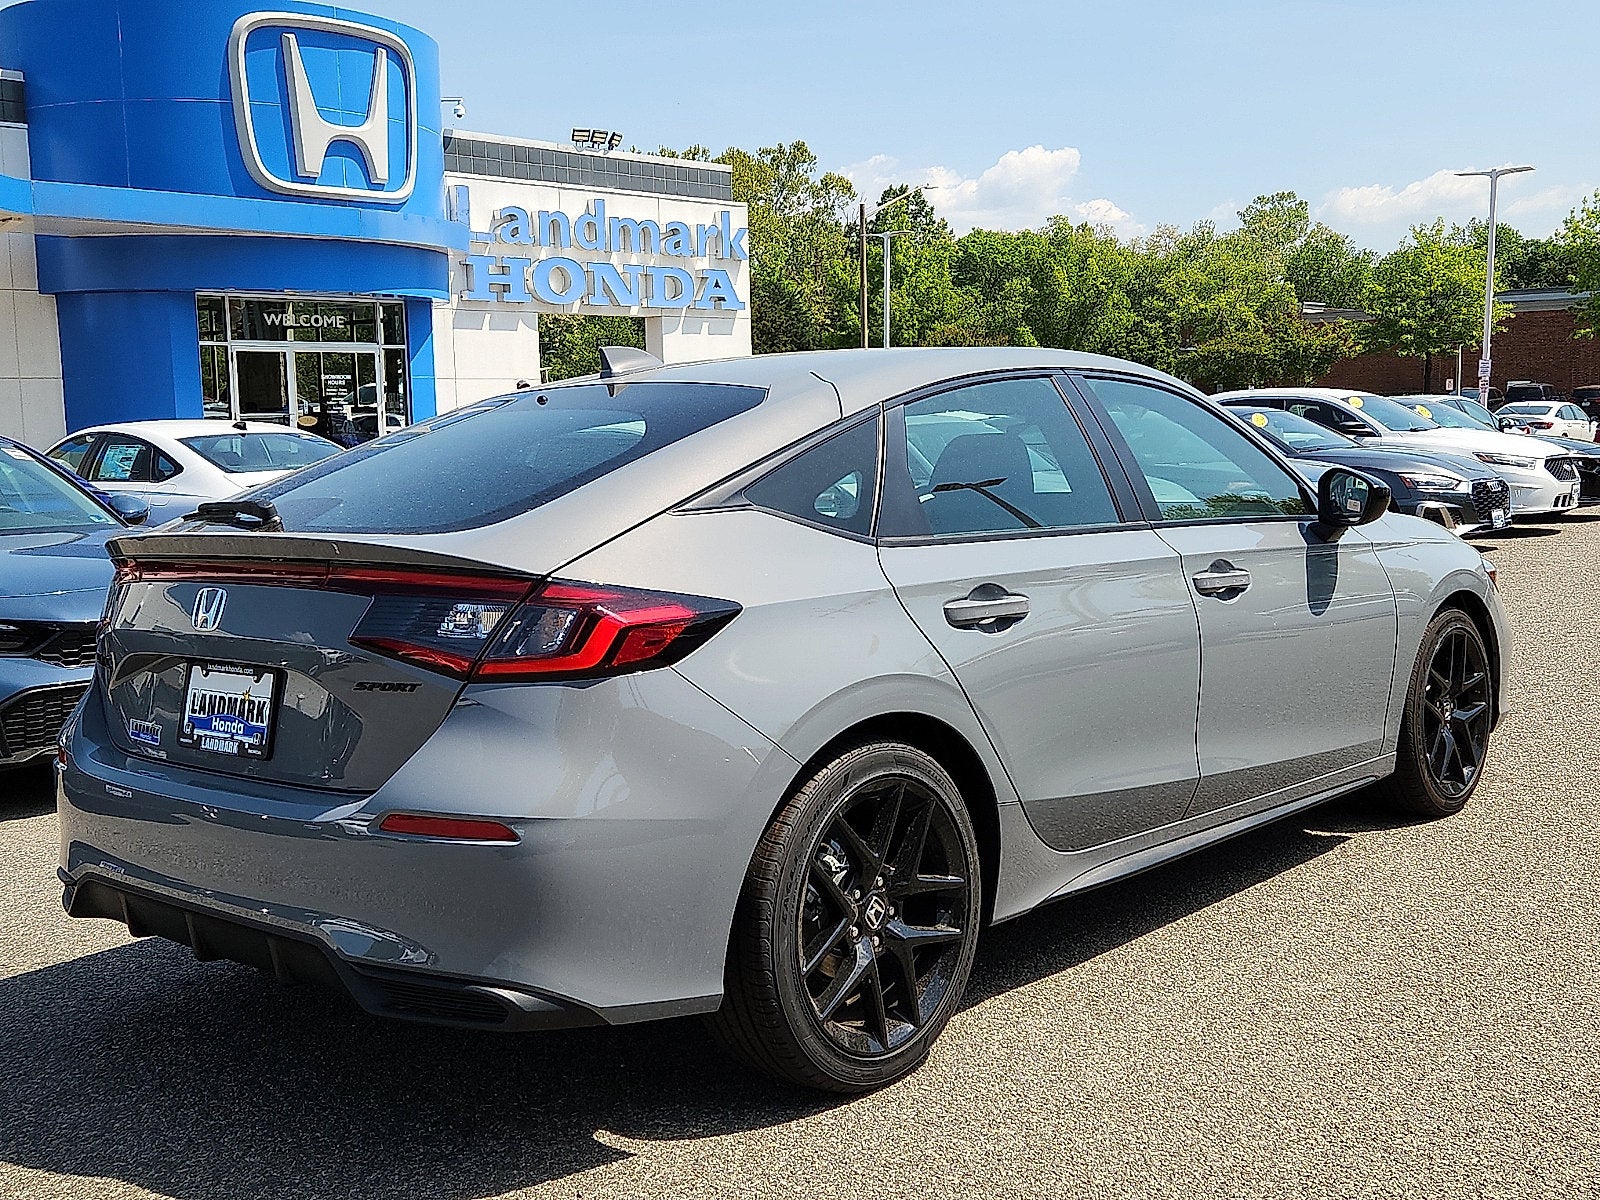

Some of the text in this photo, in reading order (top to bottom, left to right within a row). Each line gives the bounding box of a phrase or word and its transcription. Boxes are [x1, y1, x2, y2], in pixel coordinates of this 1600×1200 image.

[455, 185, 748, 261] Landmark
[463, 254, 745, 311] HONDA
[262, 312, 347, 328] WELCOME
[352, 681, 423, 693] SPORT
[190, 689, 270, 725] LANDMARK
[211, 717, 245, 735] Honda
[201, 736, 240, 754] LANDMARK
